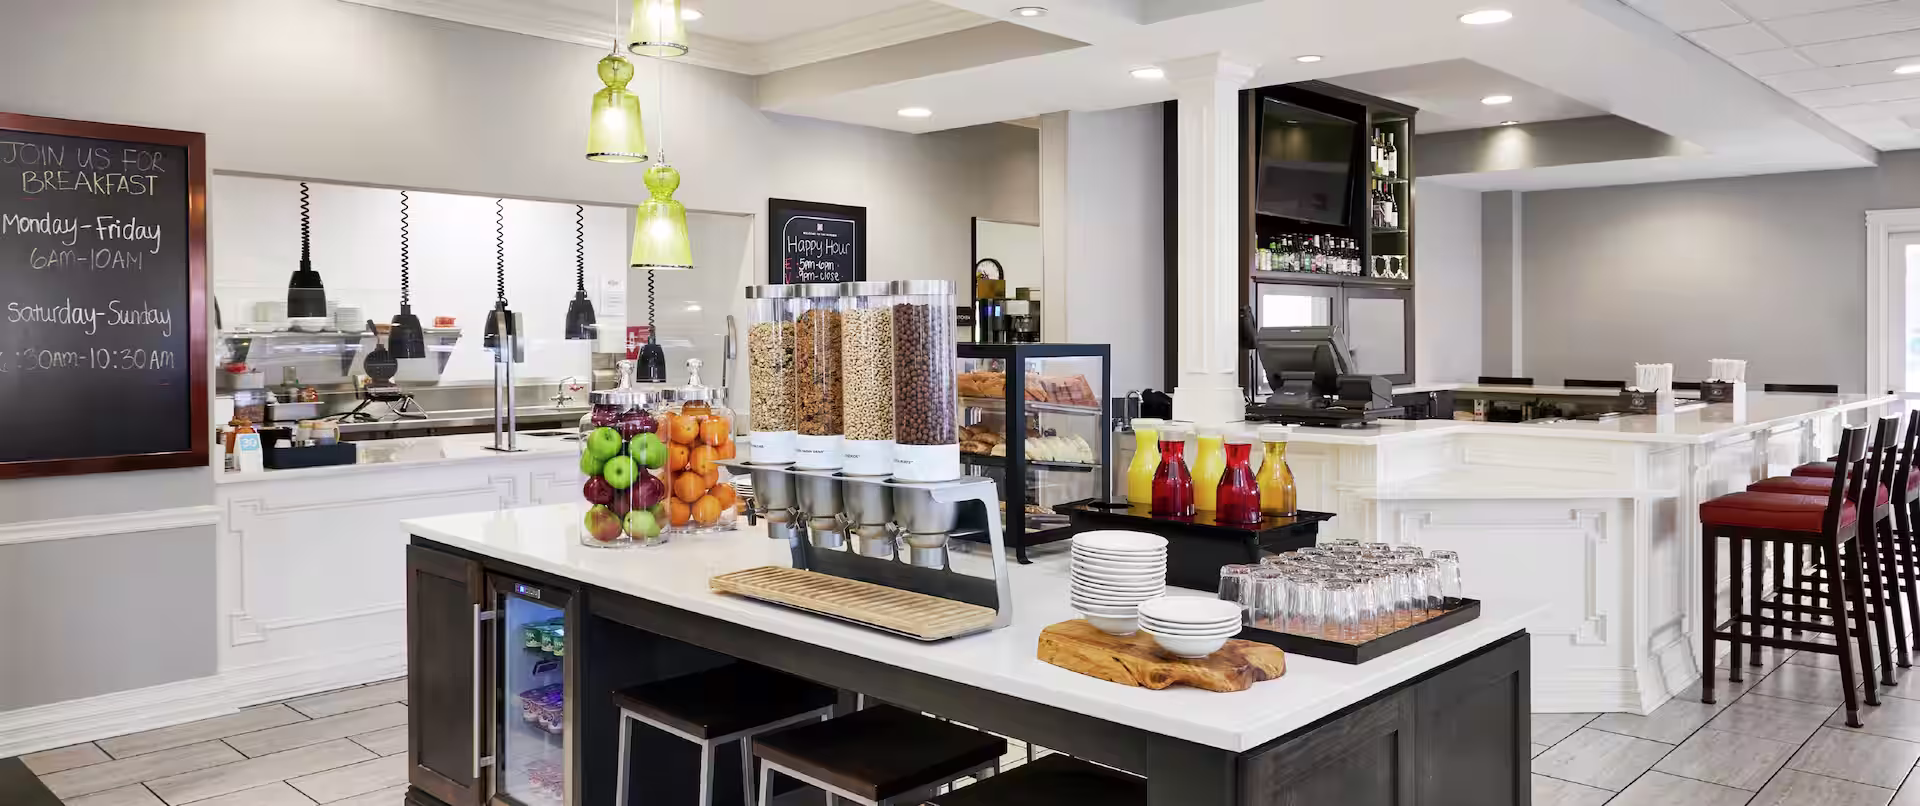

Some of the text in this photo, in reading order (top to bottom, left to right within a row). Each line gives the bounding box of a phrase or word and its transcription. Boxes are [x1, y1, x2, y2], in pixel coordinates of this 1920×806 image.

[0, 141, 165, 172] JOIN US FOR
[22, 170, 158, 196] BREAKFAST
[787, 235, 851, 258] Happy Hour
